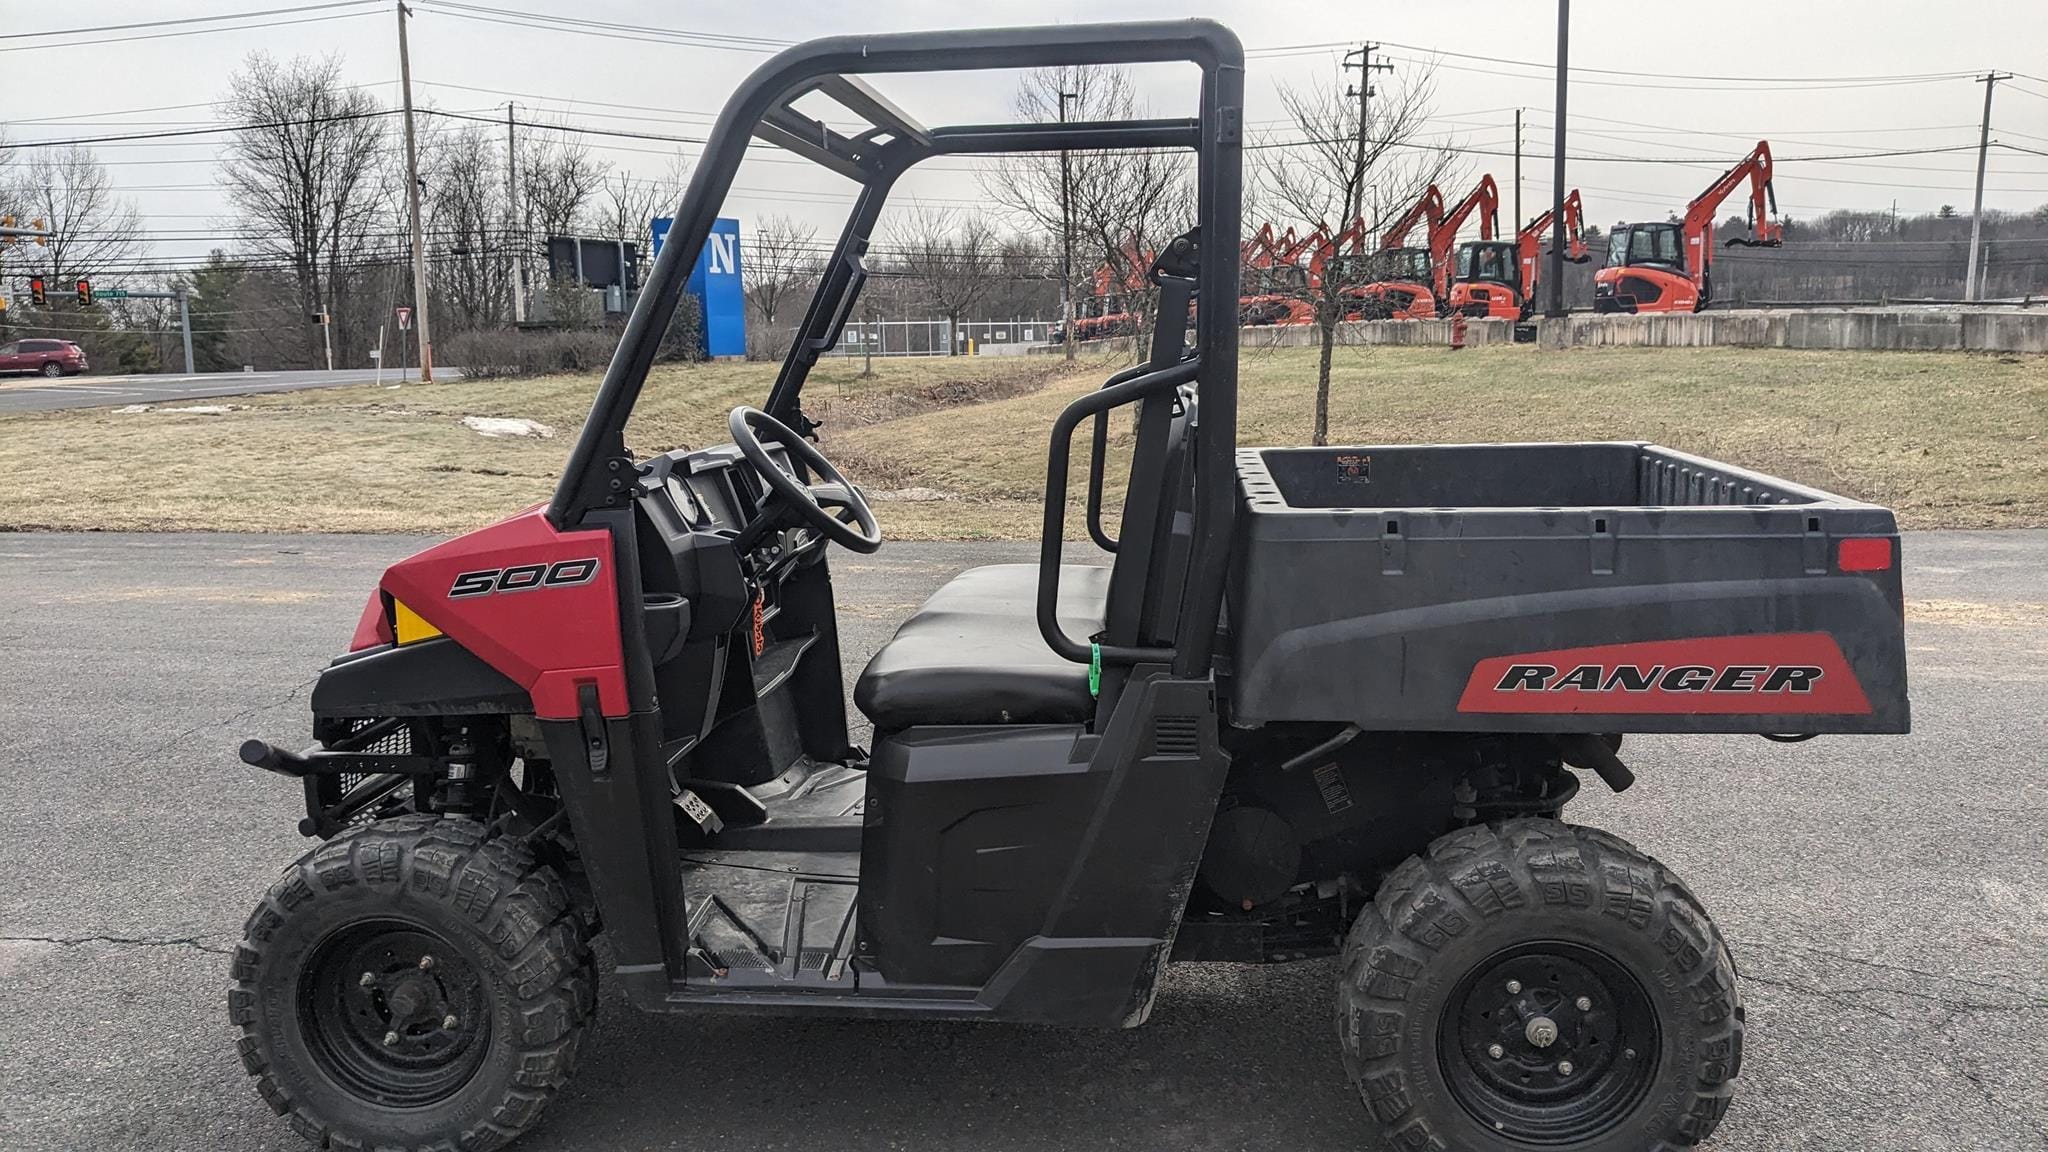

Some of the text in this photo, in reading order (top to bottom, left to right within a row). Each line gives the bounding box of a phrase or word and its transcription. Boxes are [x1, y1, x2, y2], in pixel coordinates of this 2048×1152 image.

[709, 233, 735, 274] N
[448, 557, 601, 600] 500
[755, 607, 763, 652] Kubota
[1494, 664, 1825, 693] RANGER
